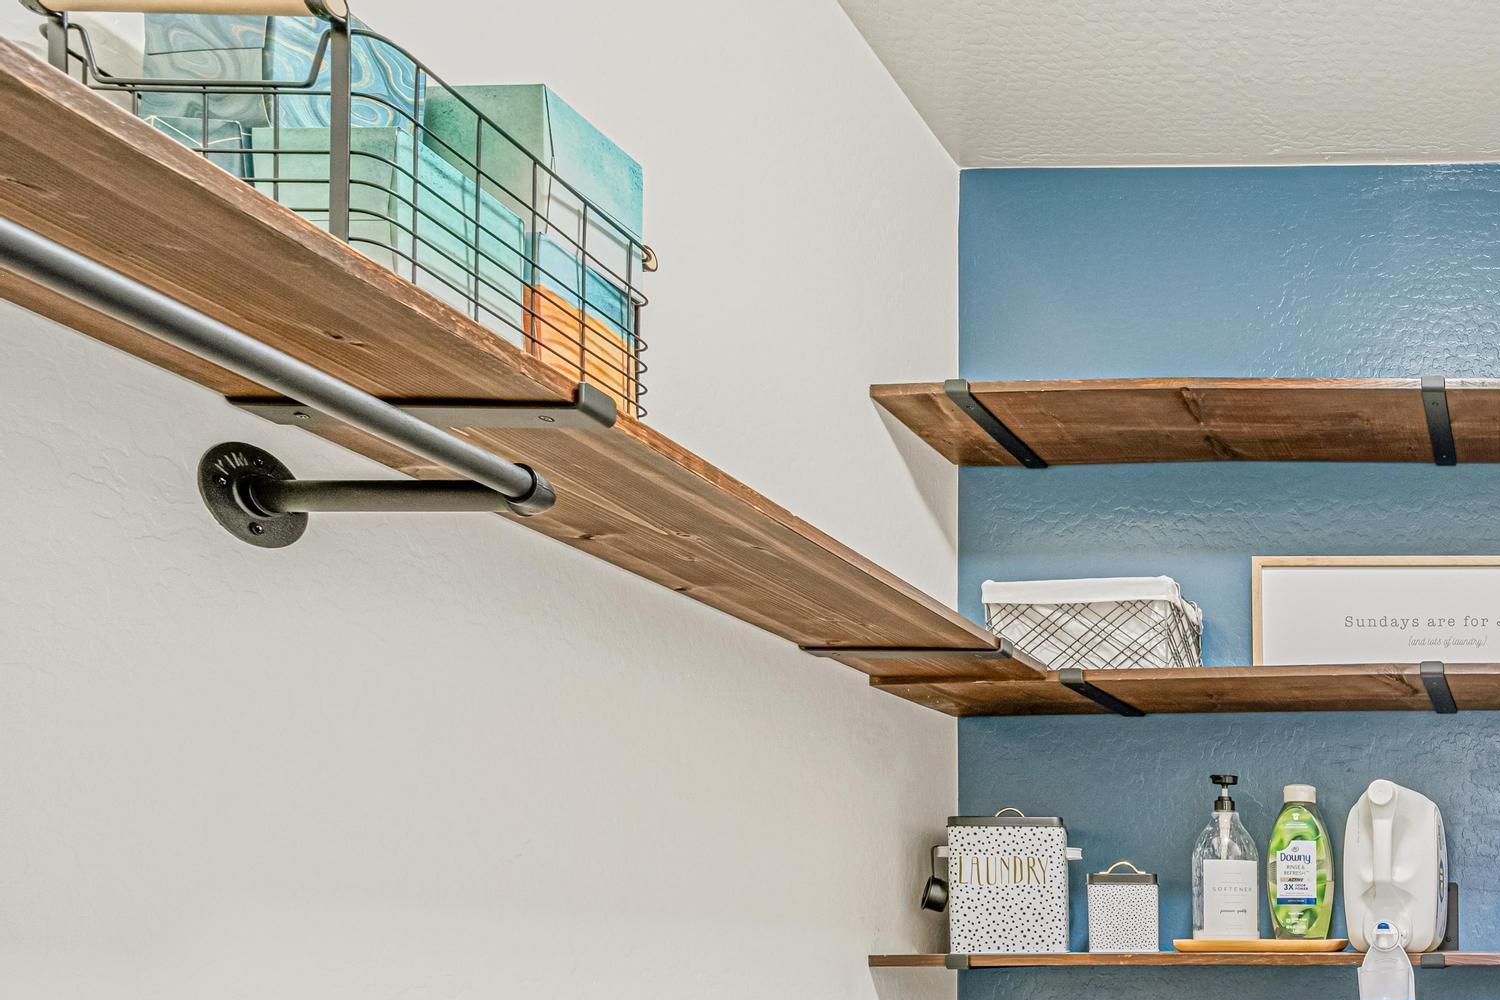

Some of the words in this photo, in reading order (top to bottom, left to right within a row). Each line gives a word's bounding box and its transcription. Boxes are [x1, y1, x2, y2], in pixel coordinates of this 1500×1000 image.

[1344, 615, 1420, 630] Sundays
[1427, 617, 1456, 627] are
[1463, 615, 1489, 627] for
[1280, 853, 1311, 864] Downy
[959, 855, 1049, 886] LAUNDRY
